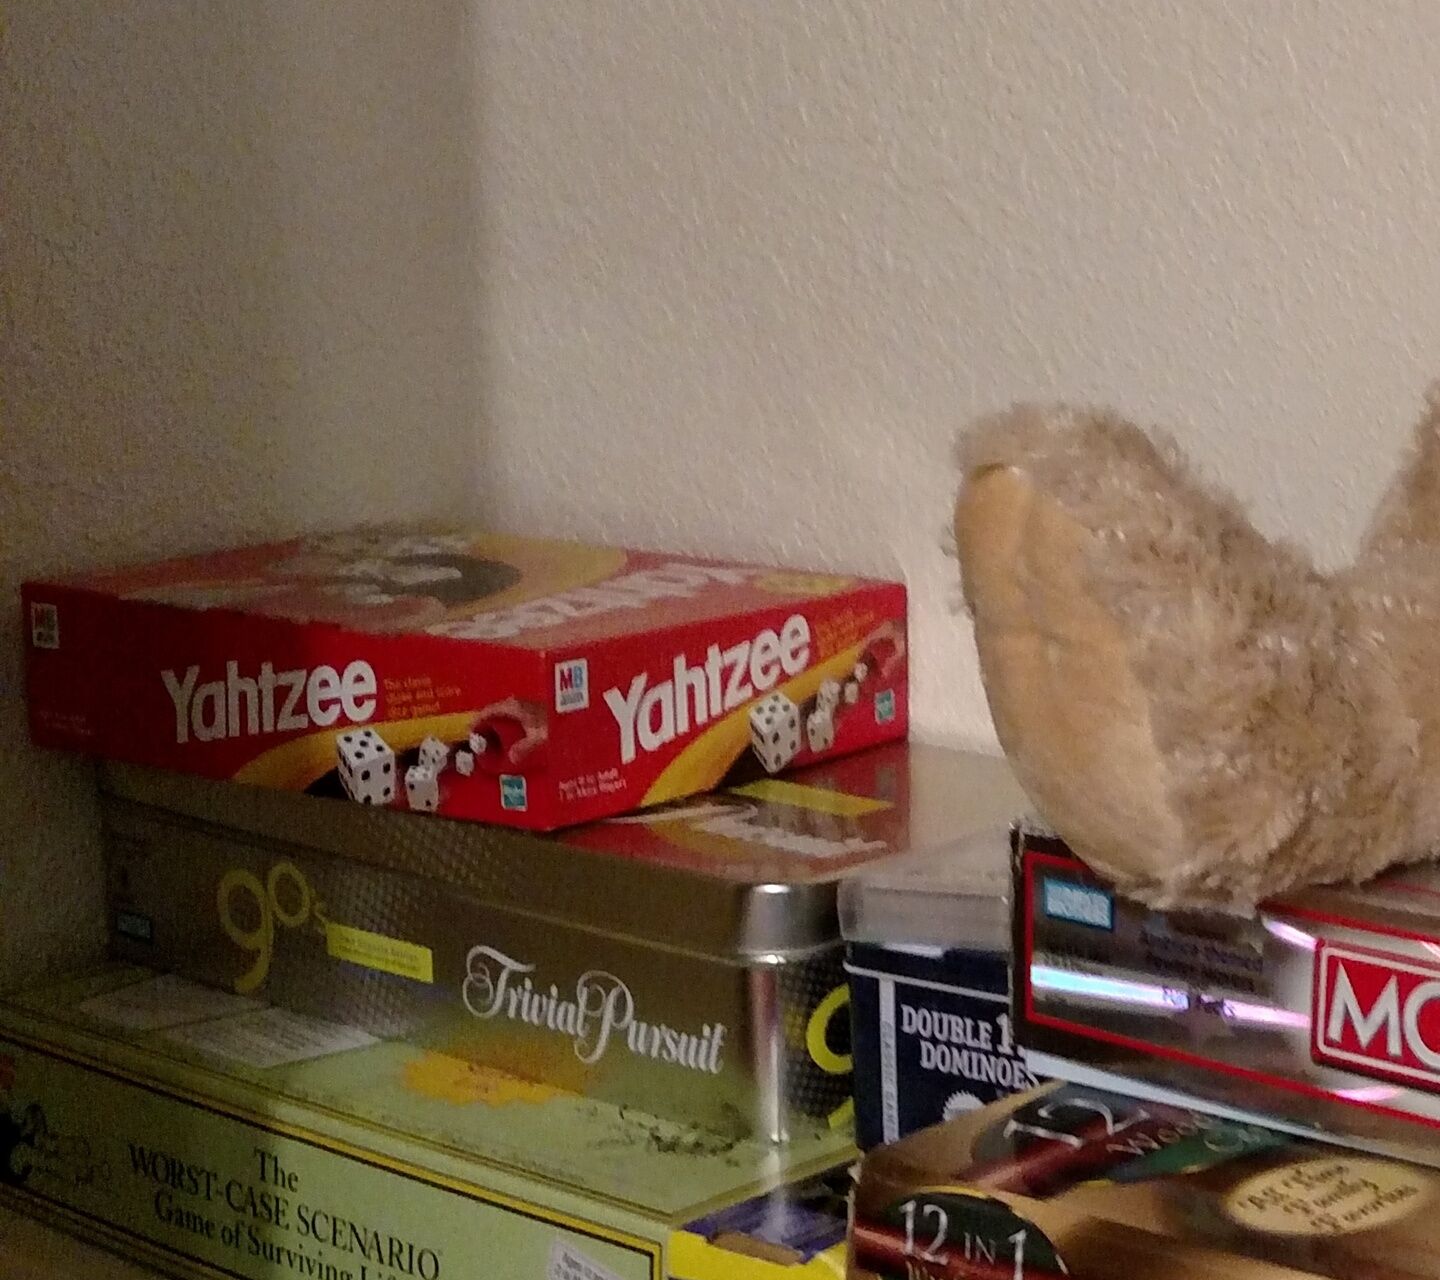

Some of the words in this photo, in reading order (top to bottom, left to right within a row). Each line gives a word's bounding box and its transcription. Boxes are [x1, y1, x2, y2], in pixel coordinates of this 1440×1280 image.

[161, 660, 377, 744] Yahtzee
[602, 614, 811, 765] Yahtzee
[462, 944, 591, 1039] Trivial
[574, 970, 728, 1075] Pursuit
[901, 1003, 993, 1051] DOUBLE
[1003, 1097, 1151, 1149] 12
[128, 1143, 290, 1229] WORST-CASE
[255, 1146, 299, 1193] The
[154, 1188, 216, 1240] Game
[221, 1223, 243, 1249] of
[900, 1199, 949, 1266] 12
[963, 1232, 997, 1265] IN
